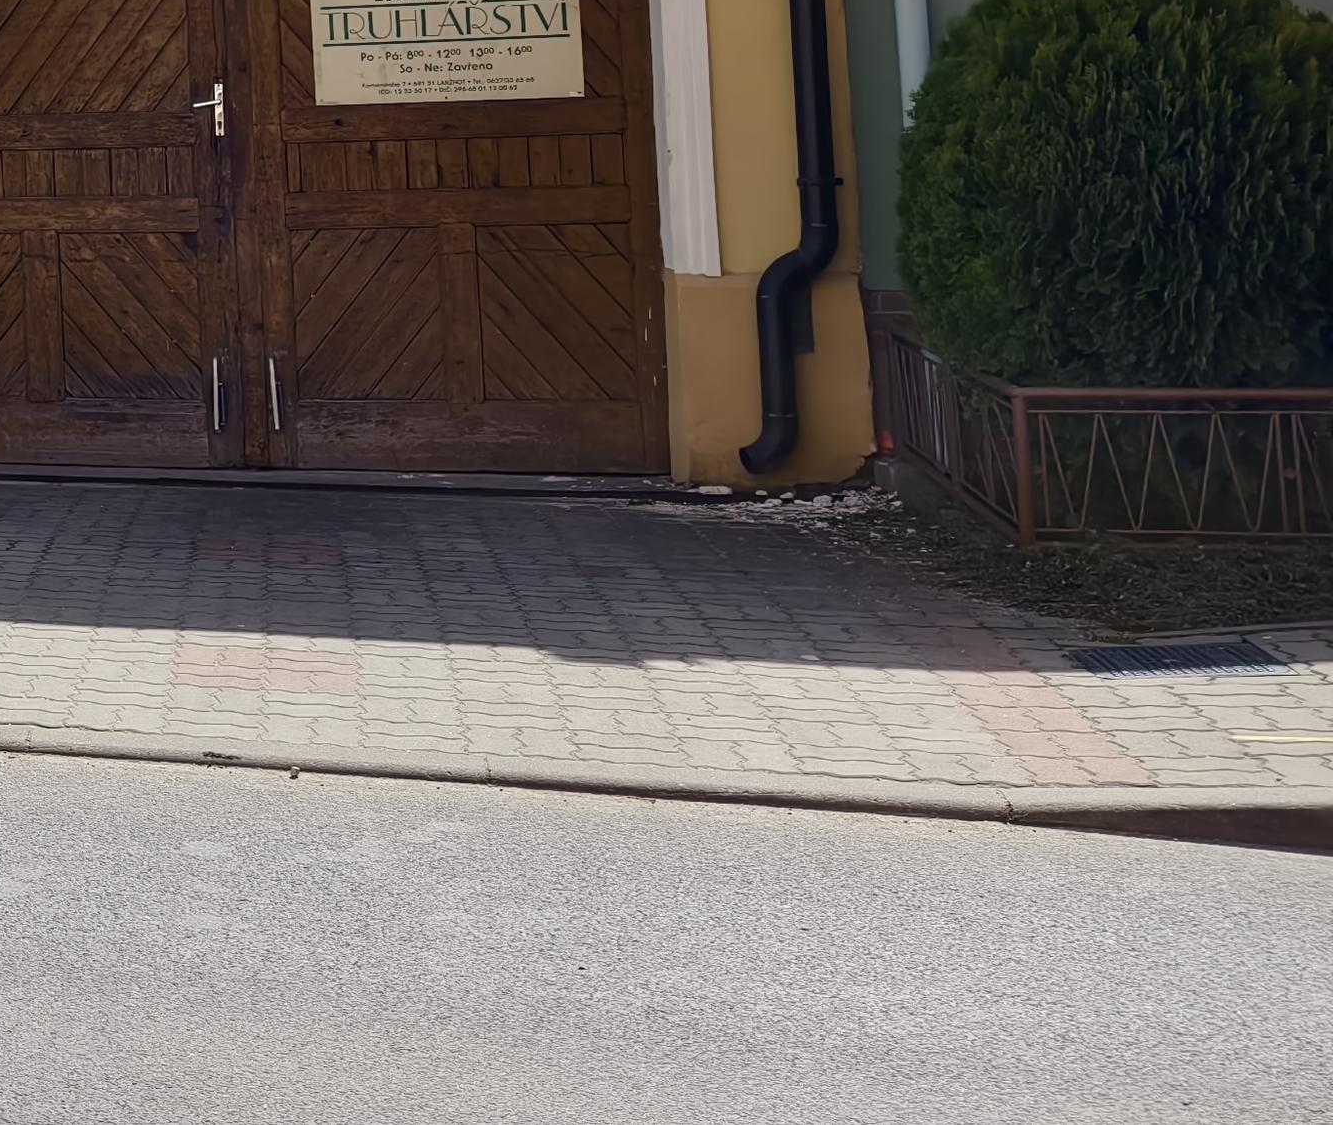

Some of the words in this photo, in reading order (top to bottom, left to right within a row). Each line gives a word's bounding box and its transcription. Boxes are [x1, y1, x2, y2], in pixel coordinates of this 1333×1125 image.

[360, 52, 374, 62] Po
[385, 50, 403, 61] Pá:
[399, 63, 413, 74] So
[424, 62, 443, 72] Ne:
[447, 61, 494, 72] Zavřeno
